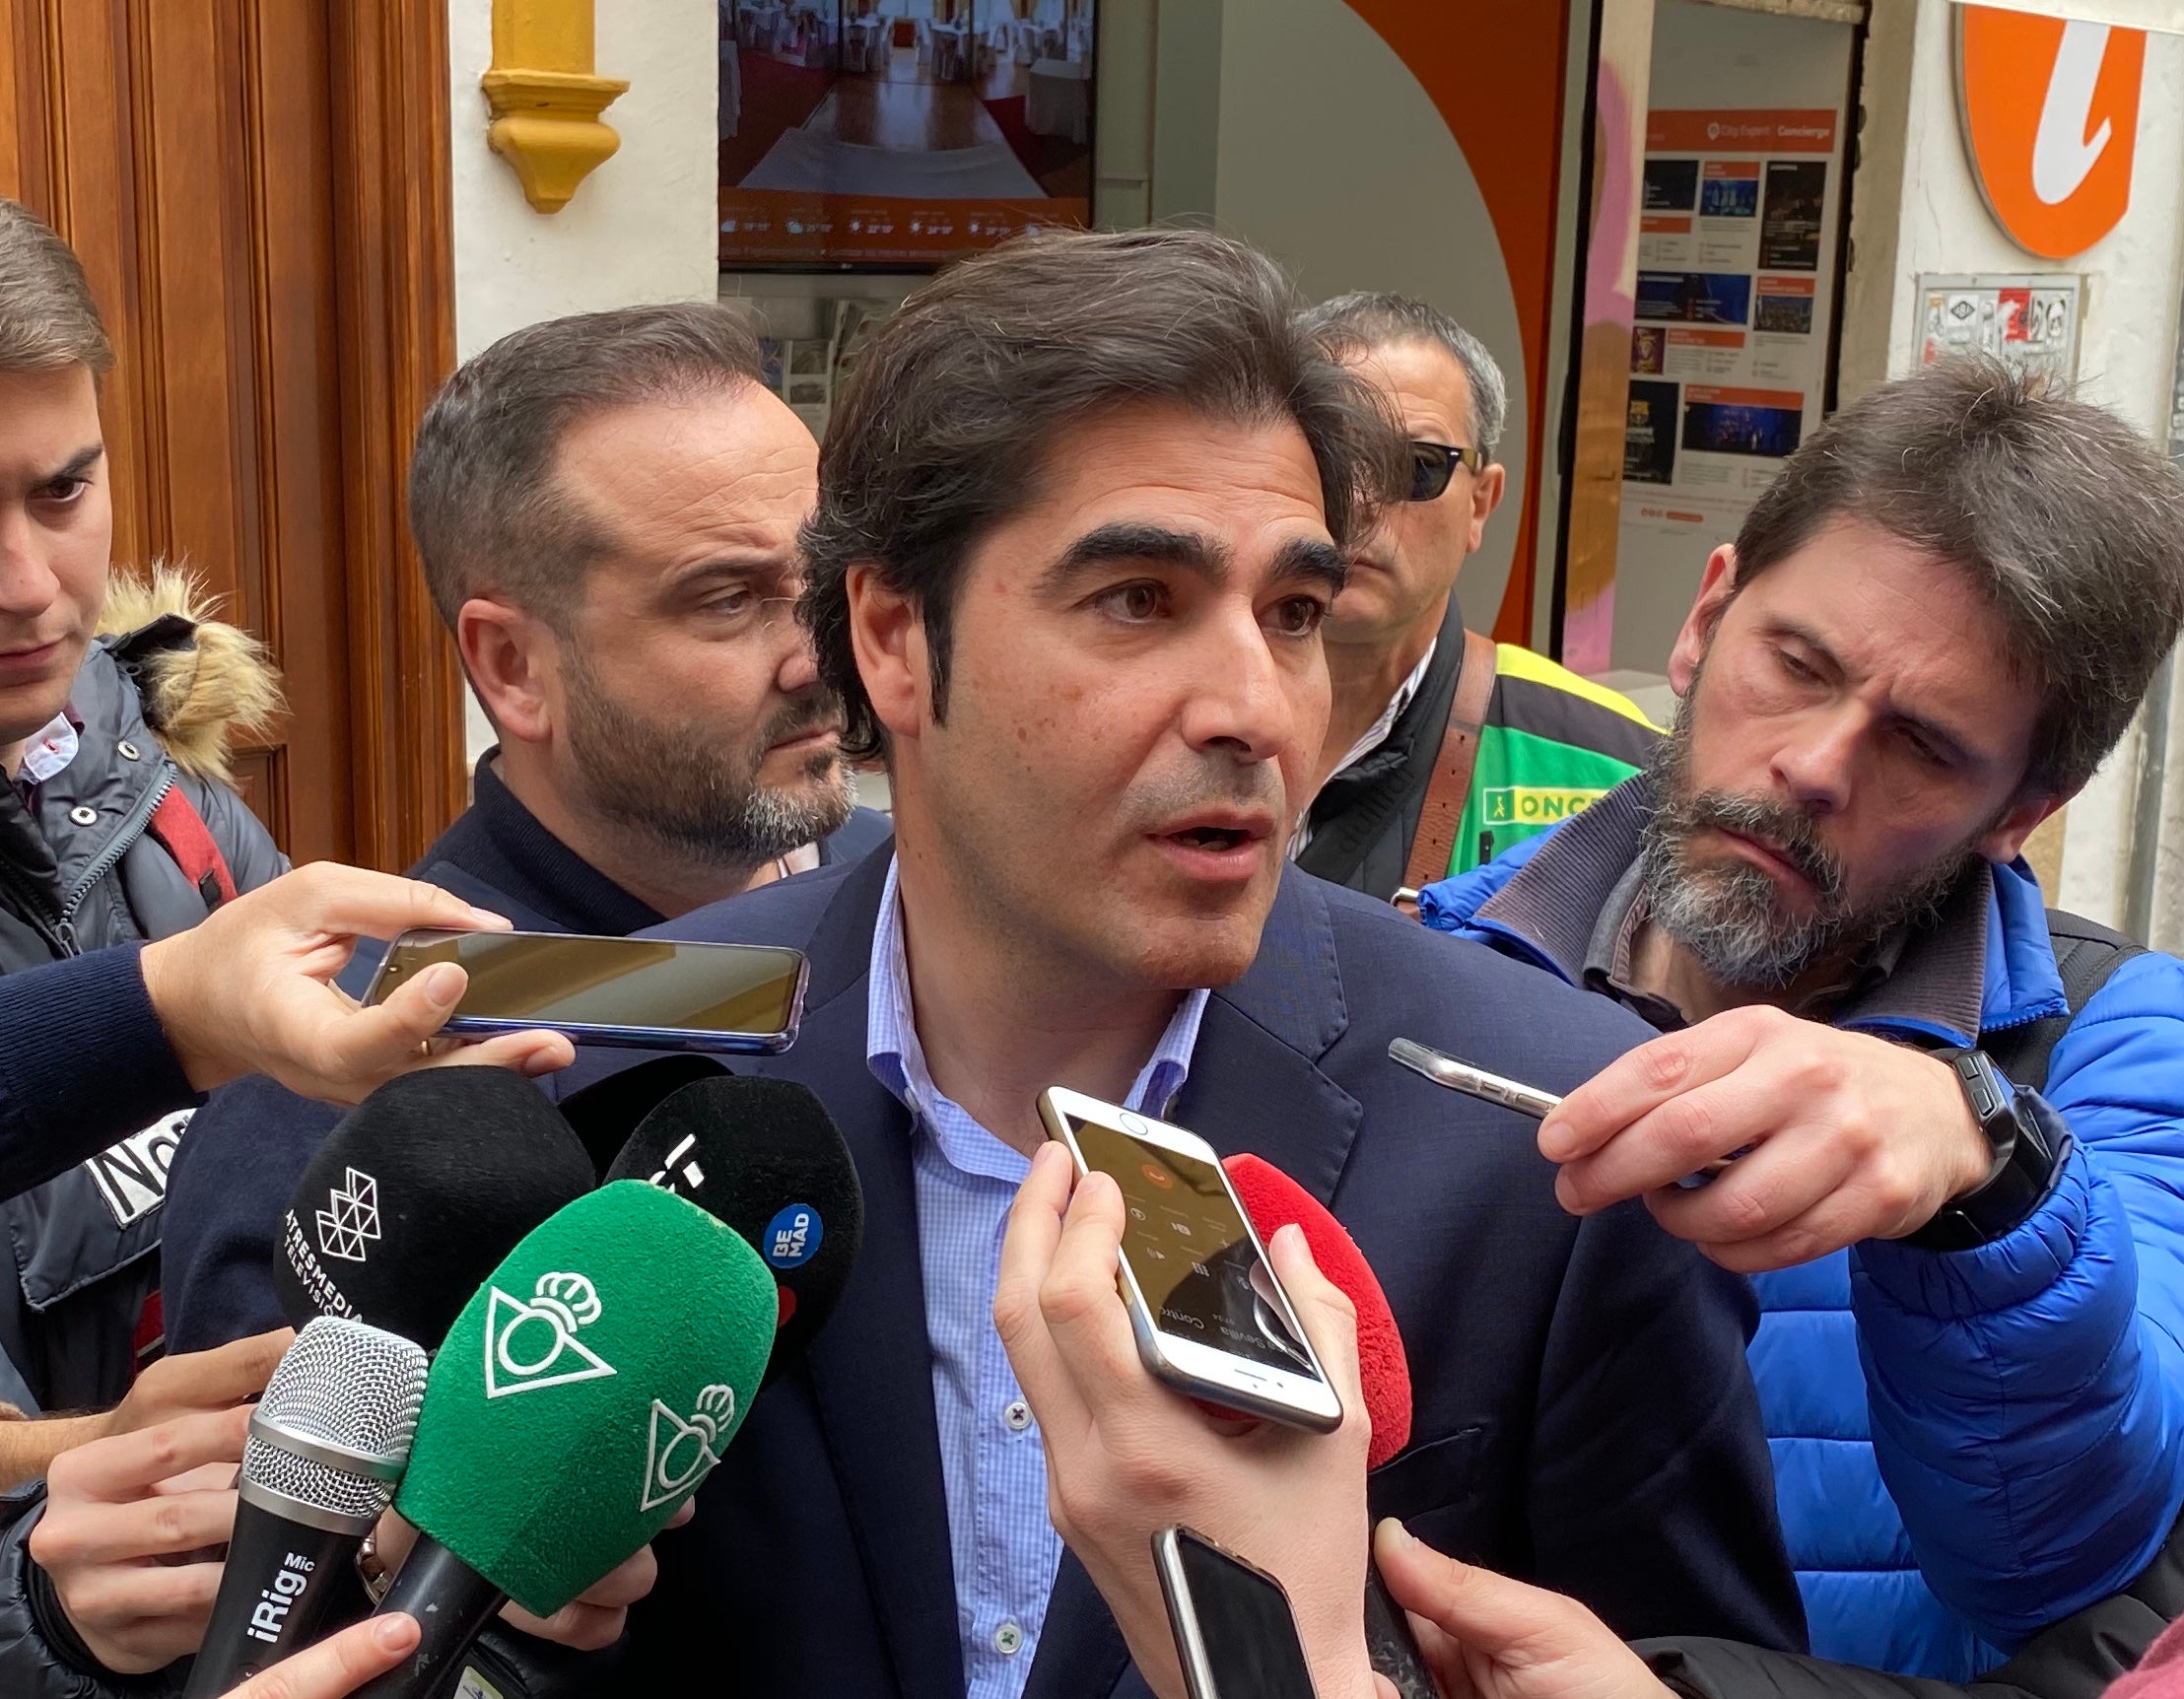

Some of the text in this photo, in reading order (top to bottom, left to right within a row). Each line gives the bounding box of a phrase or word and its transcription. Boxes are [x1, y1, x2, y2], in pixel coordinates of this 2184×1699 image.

[1522, 795, 1601, 817] ONC
[773, 1230, 792, 1257] BE
[787, 1213, 810, 1257] MAD
[246, 1552, 315, 1643] iRig Mic
